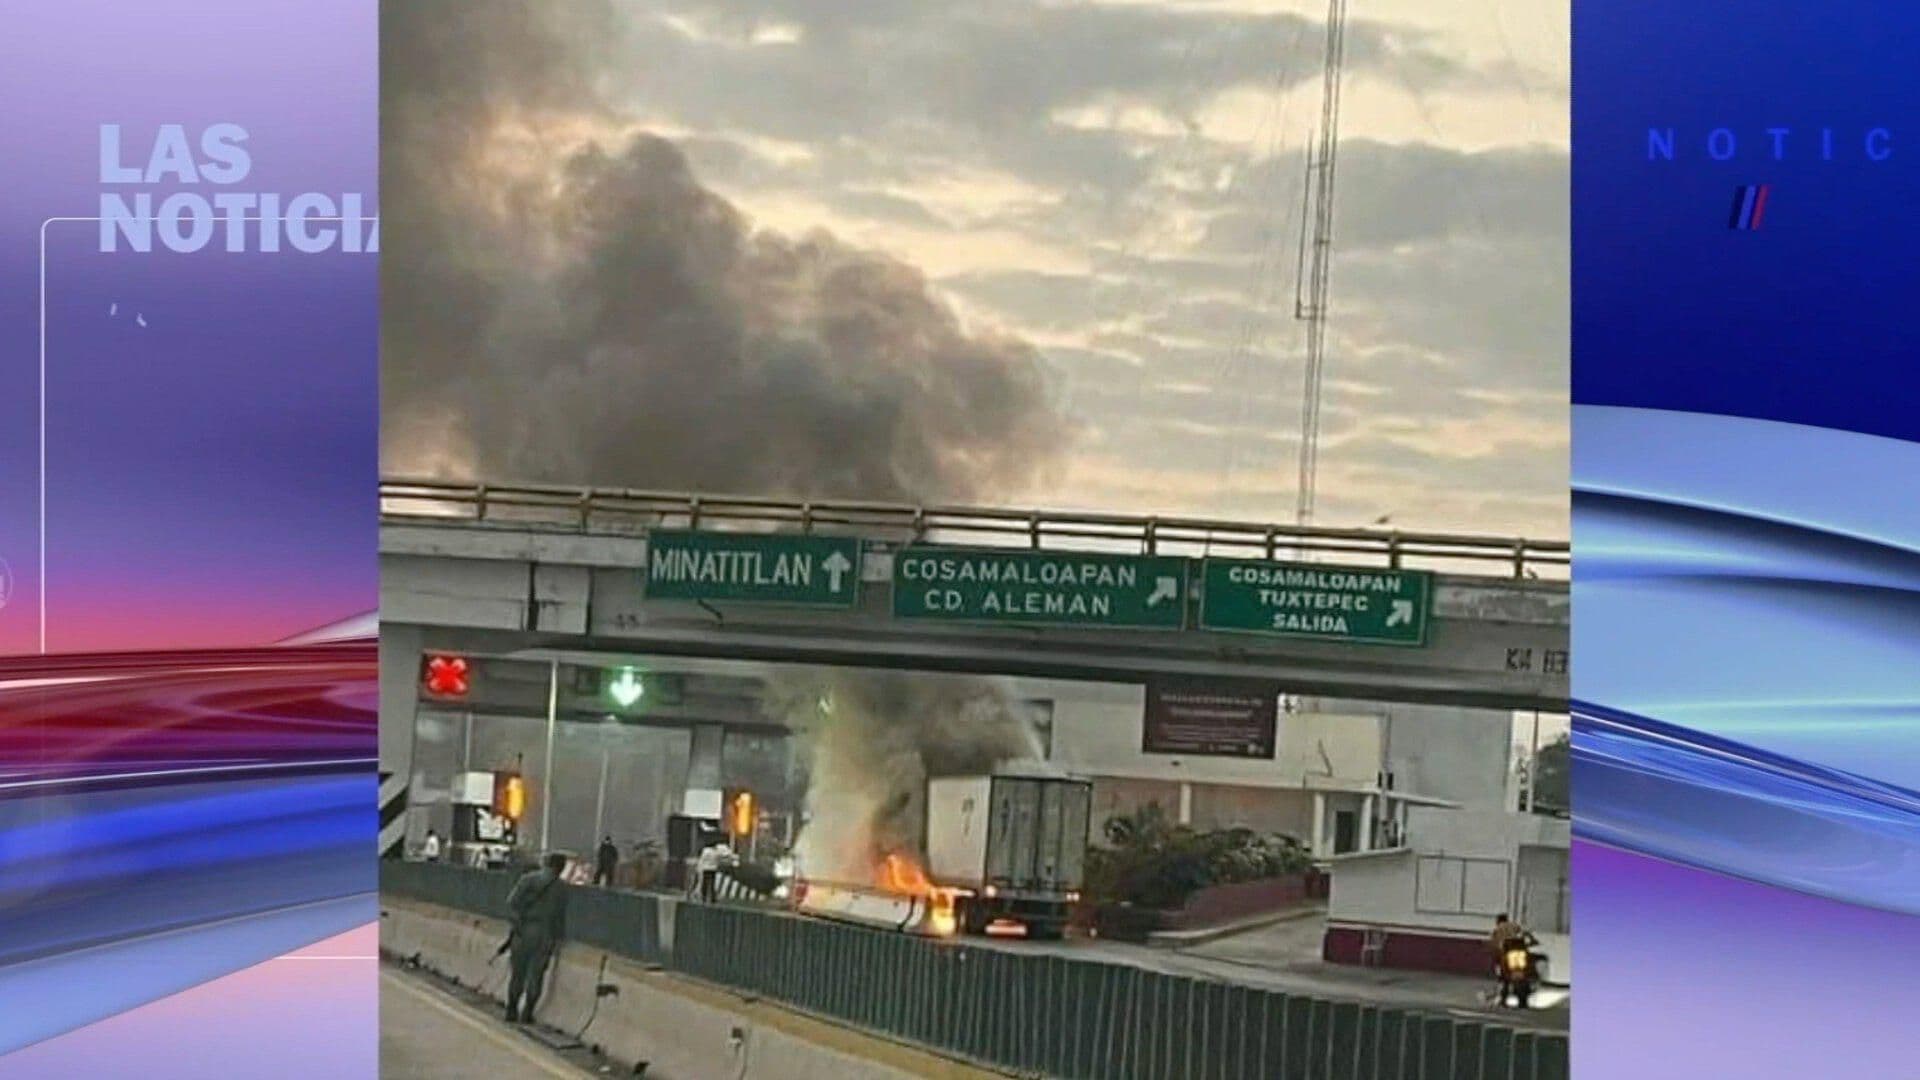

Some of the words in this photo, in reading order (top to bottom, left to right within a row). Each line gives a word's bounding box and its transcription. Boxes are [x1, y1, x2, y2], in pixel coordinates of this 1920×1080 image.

[651, 548, 812, 585] MINATITLAN
[903, 559, 1136, 587] COSAMALOAPAN
[1229, 567, 1401, 592] COSAMALOAPAN
[981, 592, 1110, 615] ALEMAN
[1258, 590, 1369, 611] TUXTEPEC
[1273, 613, 1348, 632] SALIDA
